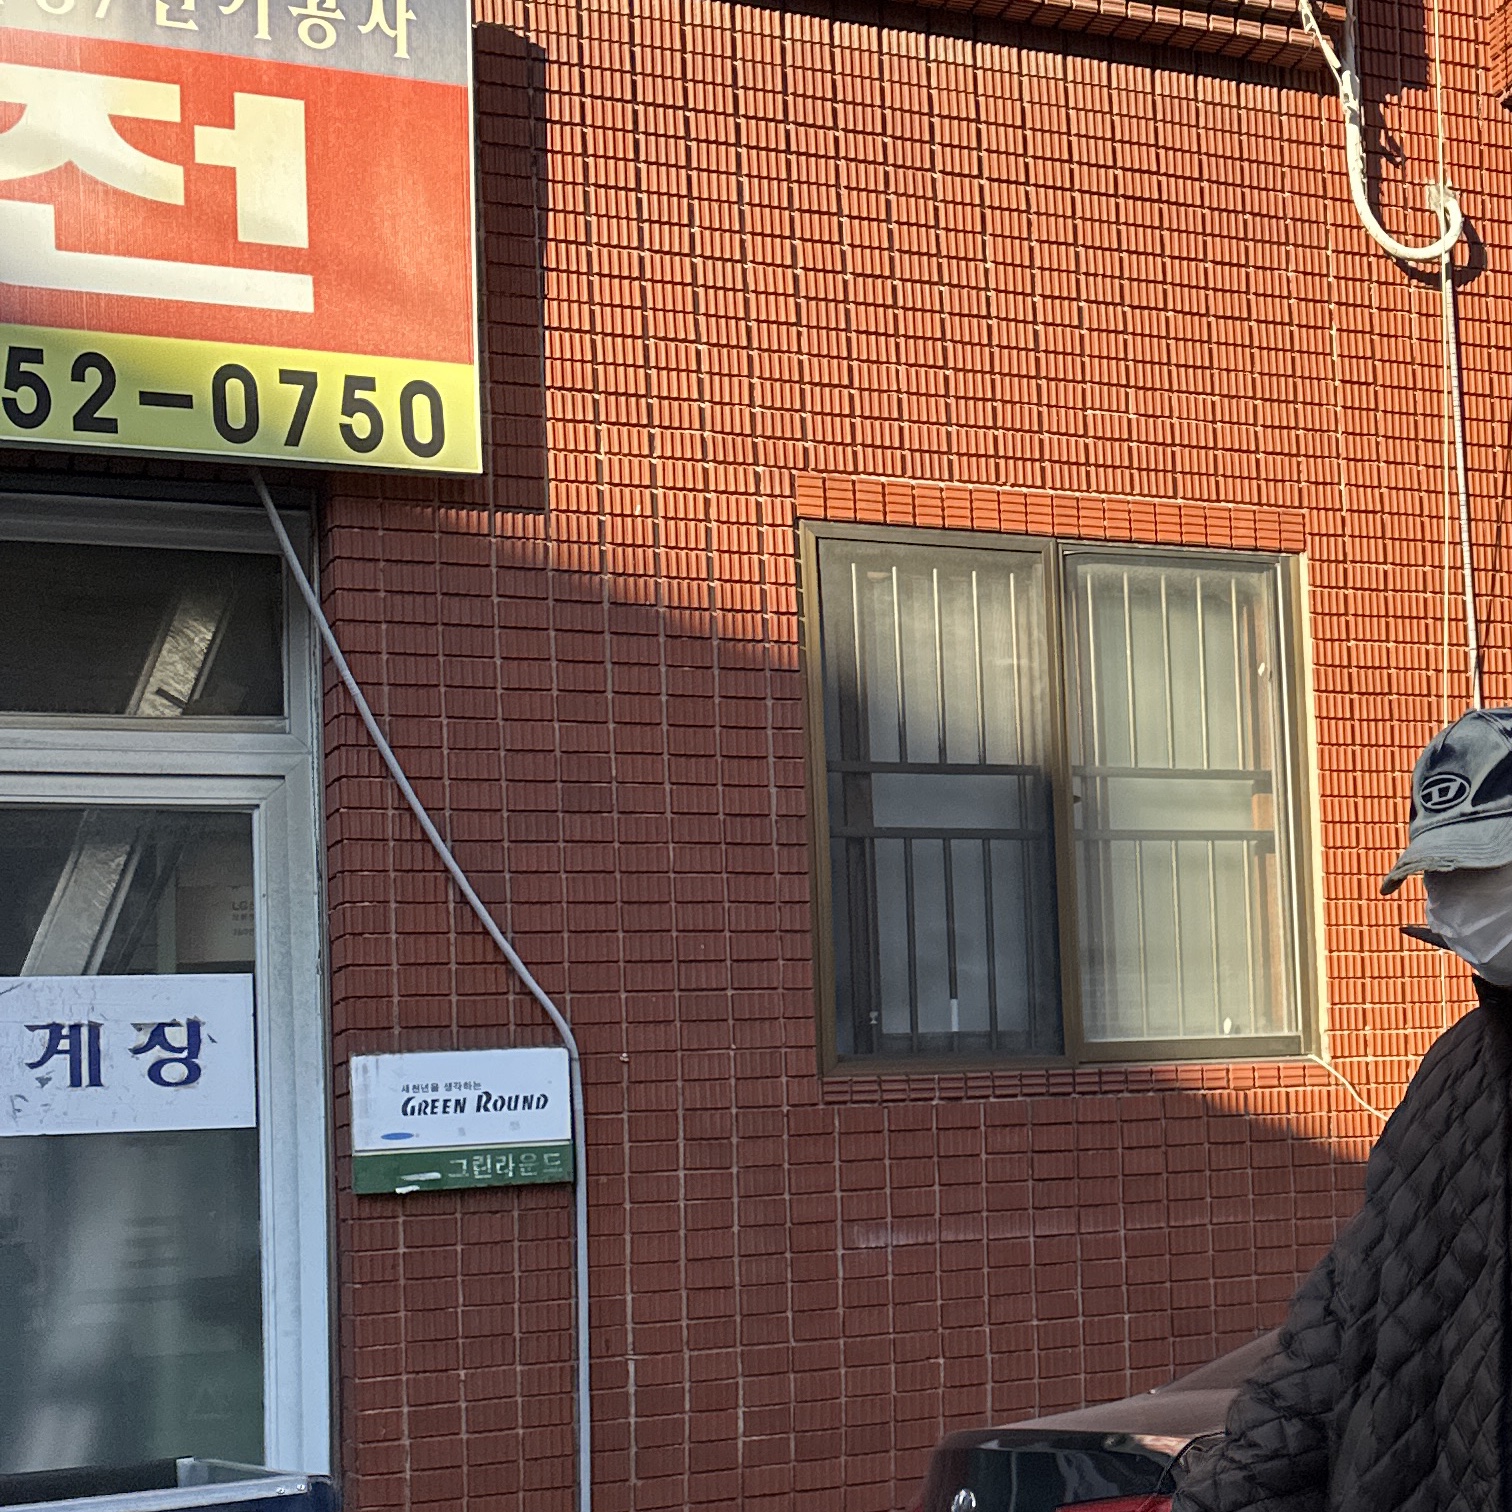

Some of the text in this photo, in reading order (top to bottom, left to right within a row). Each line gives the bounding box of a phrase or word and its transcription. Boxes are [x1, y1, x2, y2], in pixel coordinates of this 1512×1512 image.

[1, 346, 446, 458] 52-0750
[443, 1080, 482, 1092] 생각하는
[448, 1152, 563, 1179] 그린라운드
